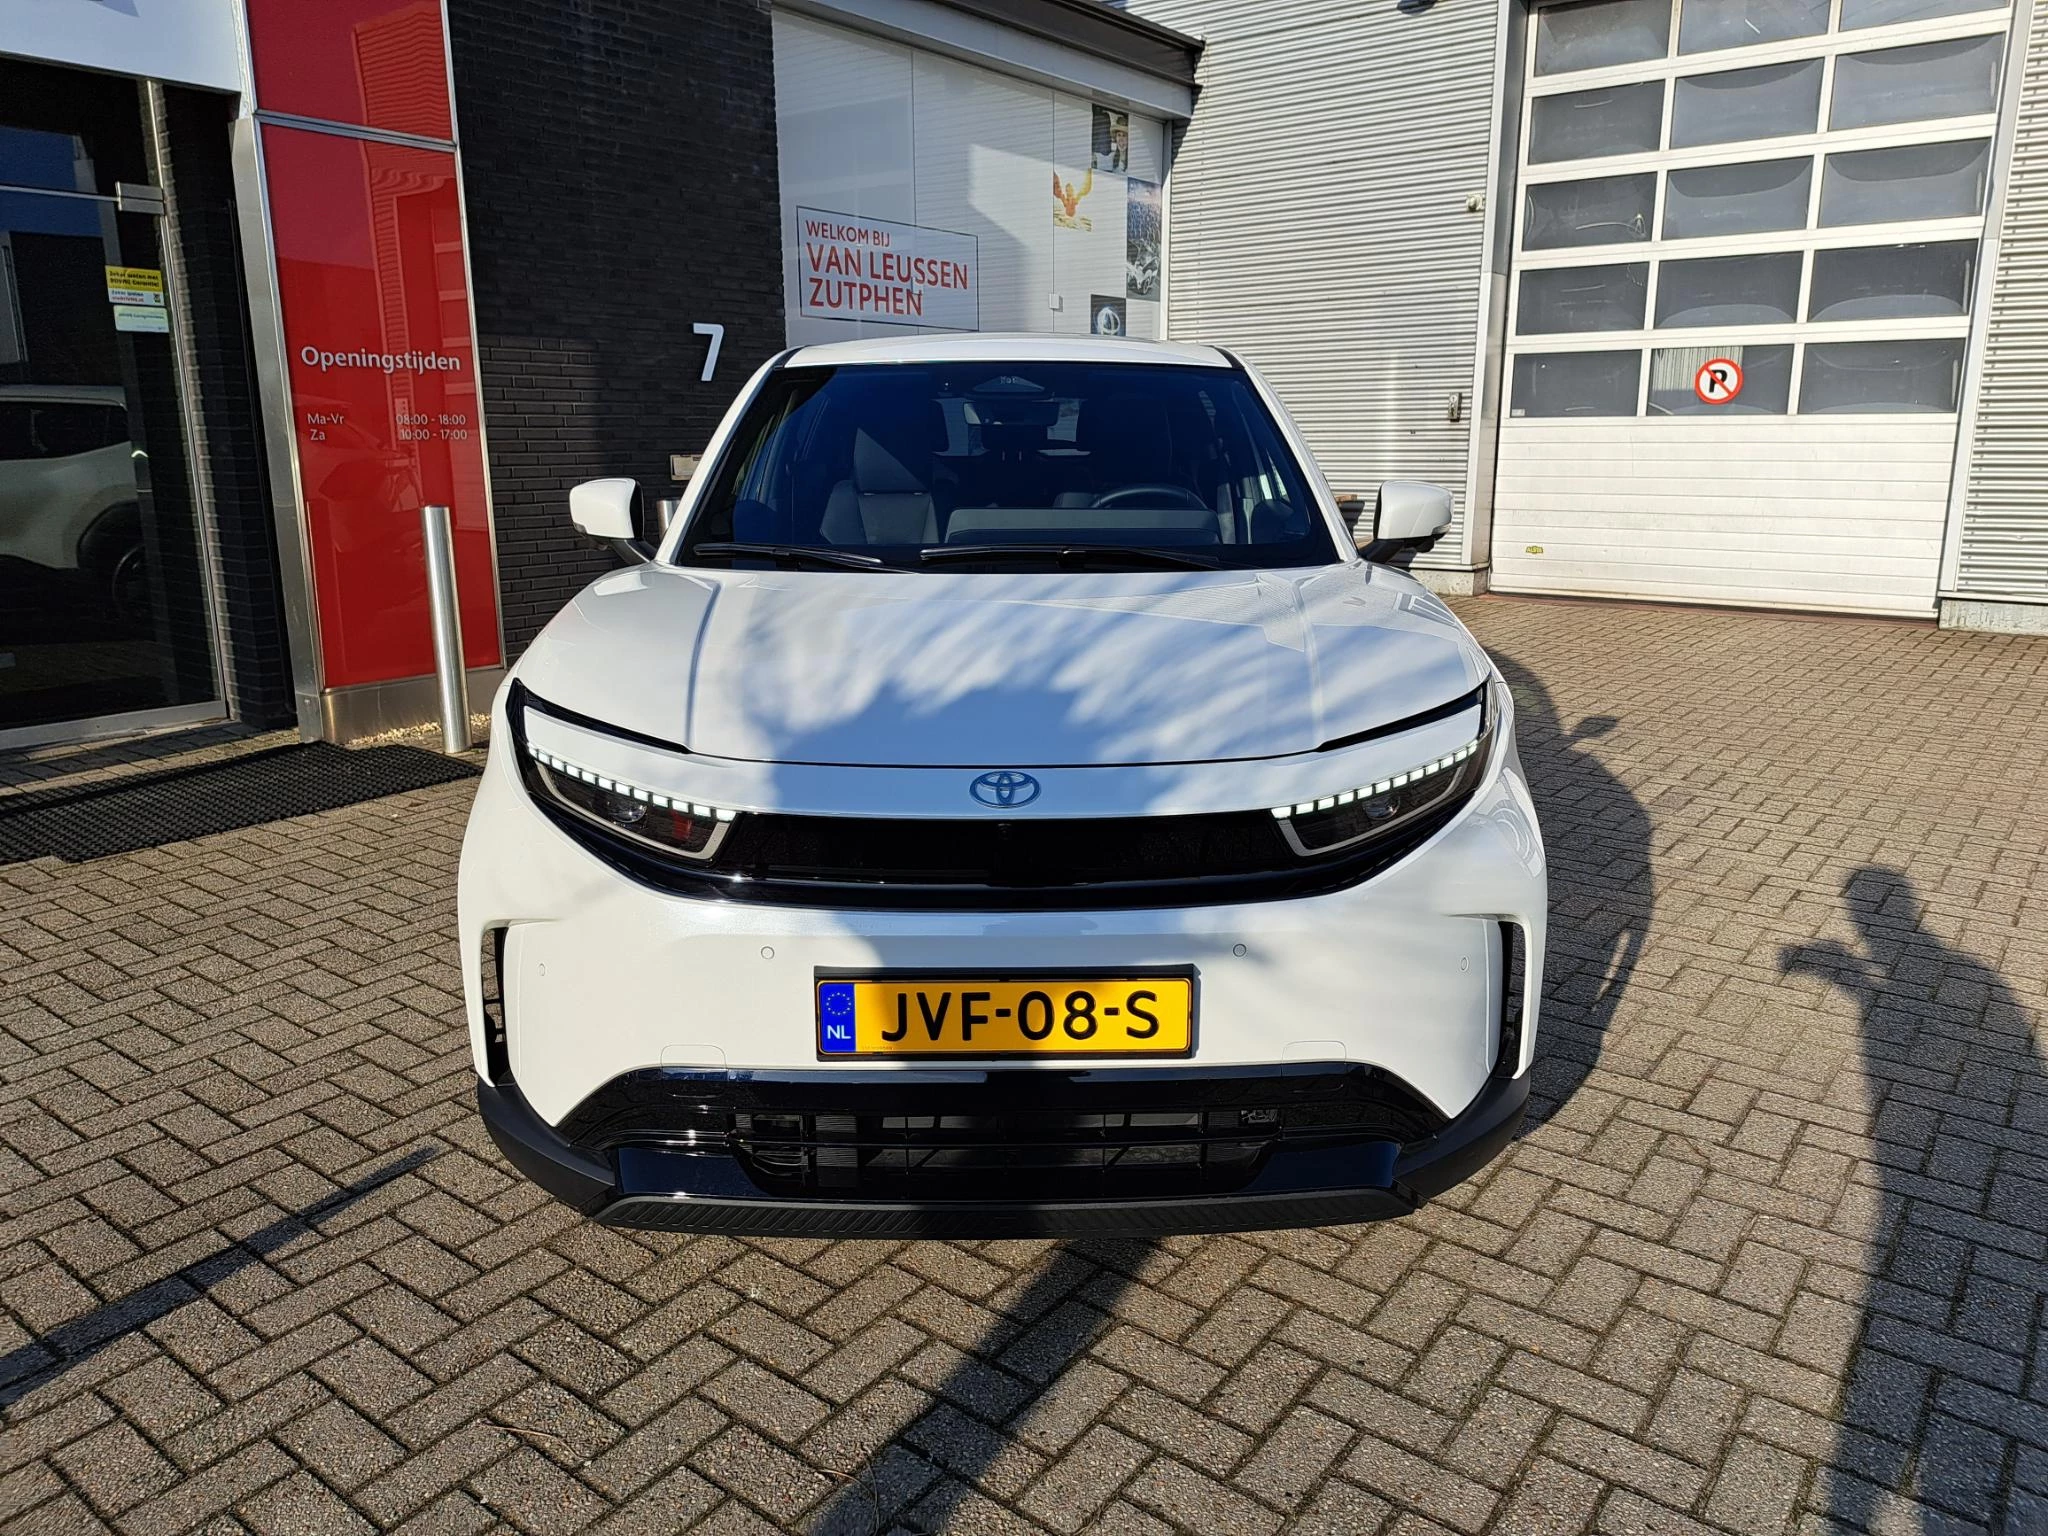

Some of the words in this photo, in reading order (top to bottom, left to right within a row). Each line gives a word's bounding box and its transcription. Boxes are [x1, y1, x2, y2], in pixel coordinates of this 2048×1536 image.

[805, 220, 869, 245] WELKOM
[873, 231, 891, 248] BIJ
[806, 242, 862, 277] VAN
[870, 251, 969, 290] LEUSSEN
[809, 277, 923, 316] ZUTPHEN
[301, 346, 461, 375] Openingstijden
[693, 322, 725, 382] 7
[1709, 369, 1728, 393] P
[307, 413, 345, 425] Ma-Vr
[396, 414, 428, 425] 08:00
[439, 414, 467, 425] 18:00
[310, 429, 326, 441] Za
[400, 429, 430, 441] 10:00
[440, 429, 468, 441] 17:00
[881, 990, 1160, 1042] JVF-08-S
[827, 1025, 852, 1040] NL
